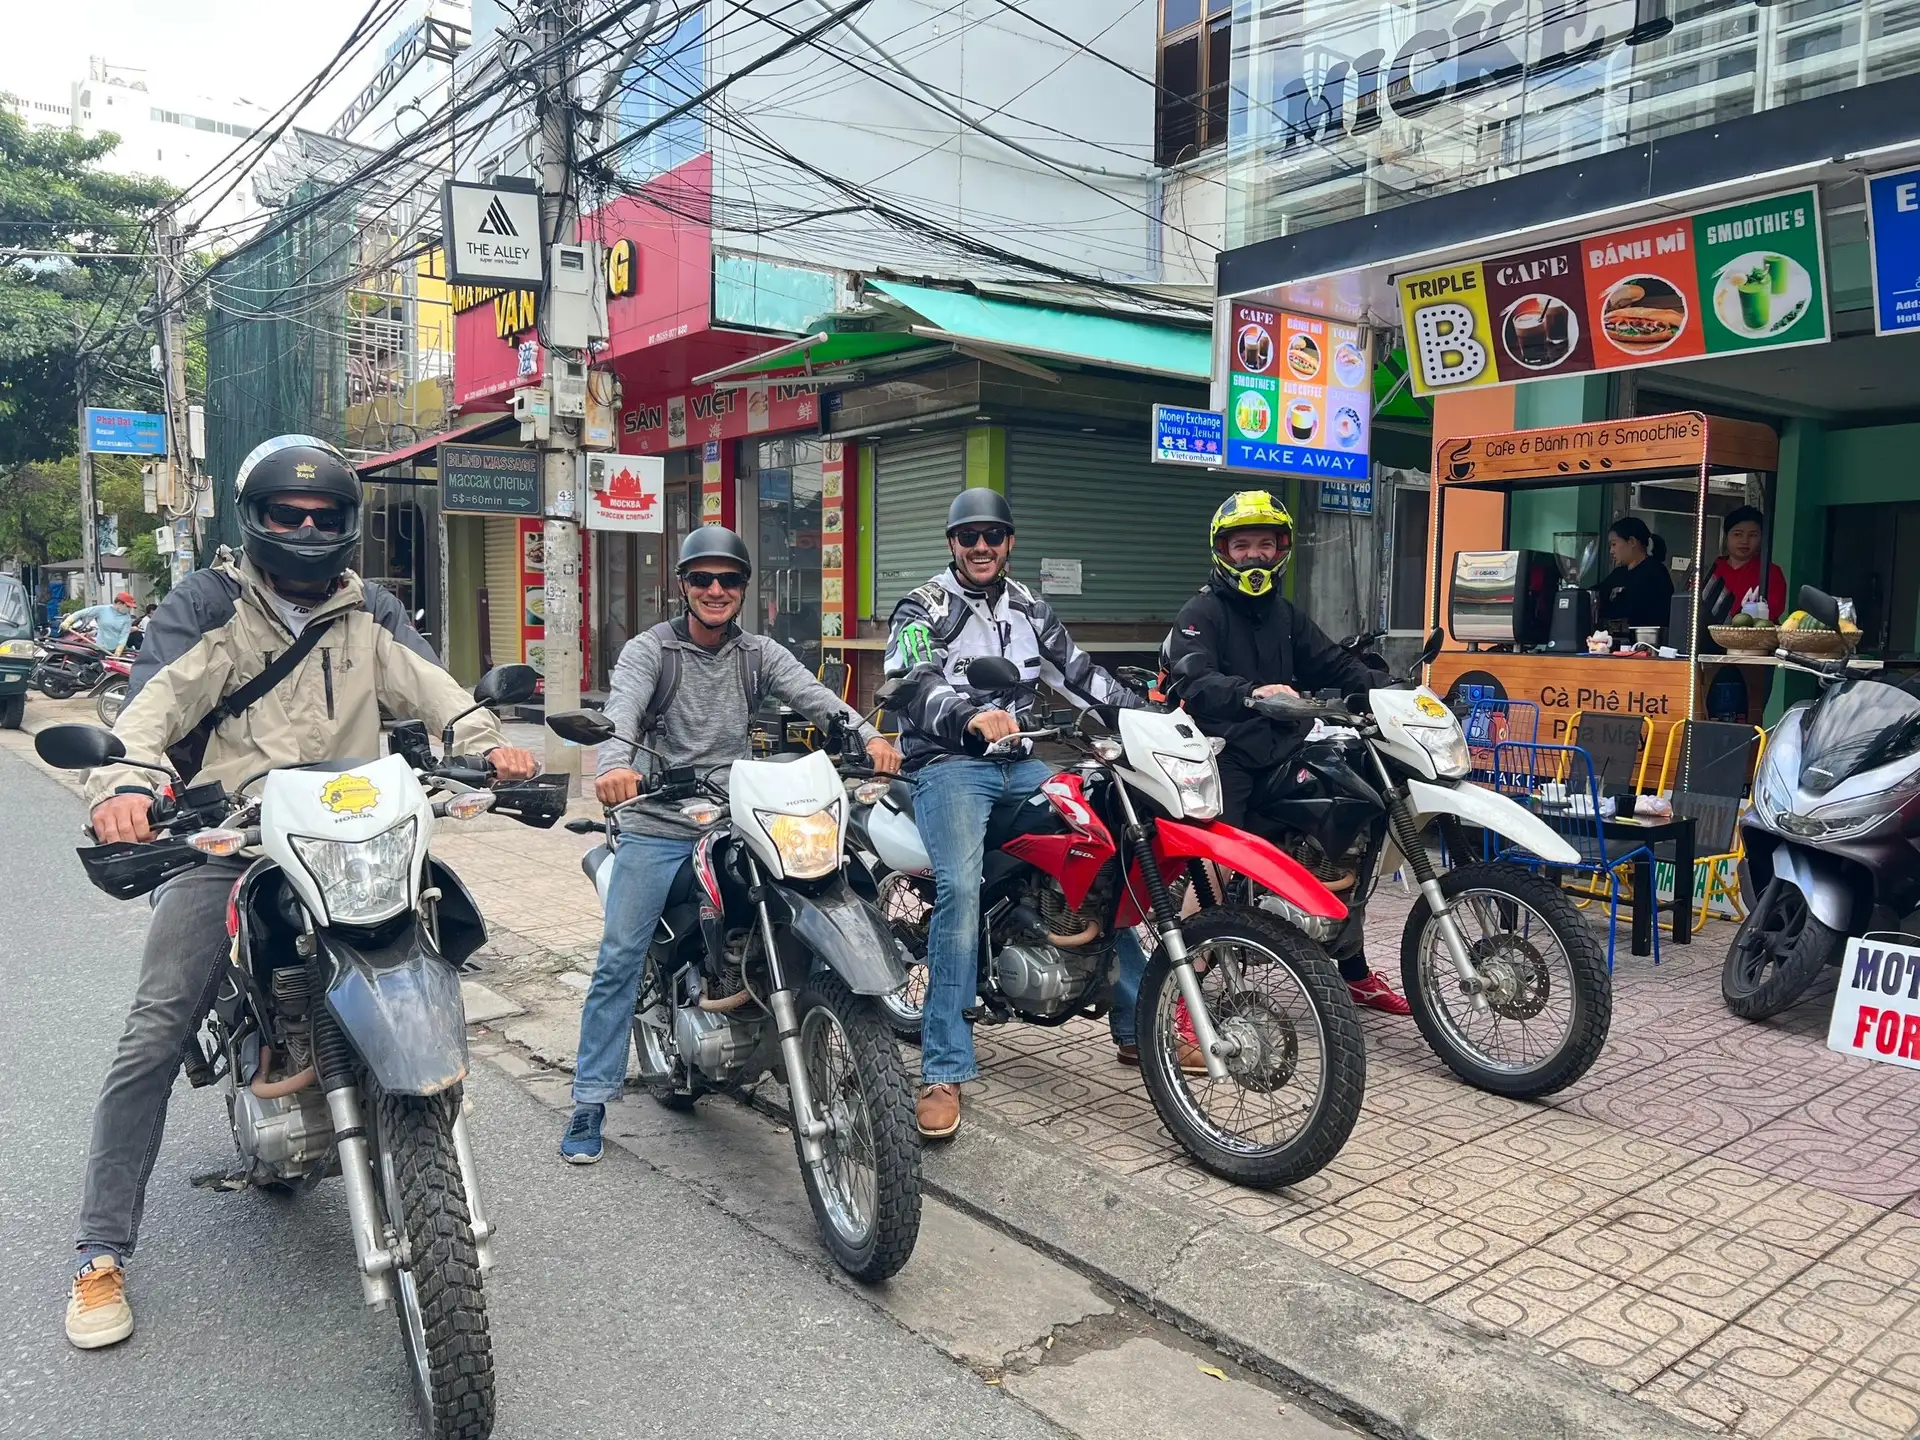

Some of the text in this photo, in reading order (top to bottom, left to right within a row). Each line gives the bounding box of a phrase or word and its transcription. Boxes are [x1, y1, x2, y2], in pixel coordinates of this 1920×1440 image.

[1707, 208, 1805, 245] SMOOTHIE'S
[466, 242, 530, 259] THE ALLEY
[1589, 227, 1686, 269] BÁNH MÌ
[1497, 255, 1569, 286] CAFE
[1406, 271, 1477, 300] TRIPLE
[493, 289, 536, 347] VẠN
[1240, 308, 1274, 325] CAFE
[1415, 303, 1486, 387] B
[1233, 374, 1276, 391] SMOOTHIE'S
[624, 403, 662, 434] SẢN
[1160, 409, 1220, 429] Money Exchange
[1160, 422, 1220, 439] Менять Деньги
[1486, 421, 1700, 457] Cafe & Bánh Mì & Smoothie's
[447, 453, 536, 472] BLIND MASSAGE
[1170, 450, 1217, 462] Vietcombank
[1241, 446, 1355, 470] TAKE AWAY
[494, 477, 535, 492] слепых
[452, 493, 503, 504] 5$=60min
[610, 499, 641, 509] МОСКВА
[1541, 686, 1668, 718] Cà Phê Hạt
[1486, 771, 1536, 789] TAKE
[786, 798, 819, 806] HONDA
[335, 813, 374, 823] HONDA
[1852, 947, 1920, 1000] MOT
[1853, 1005, 1920, 1061] FOR
